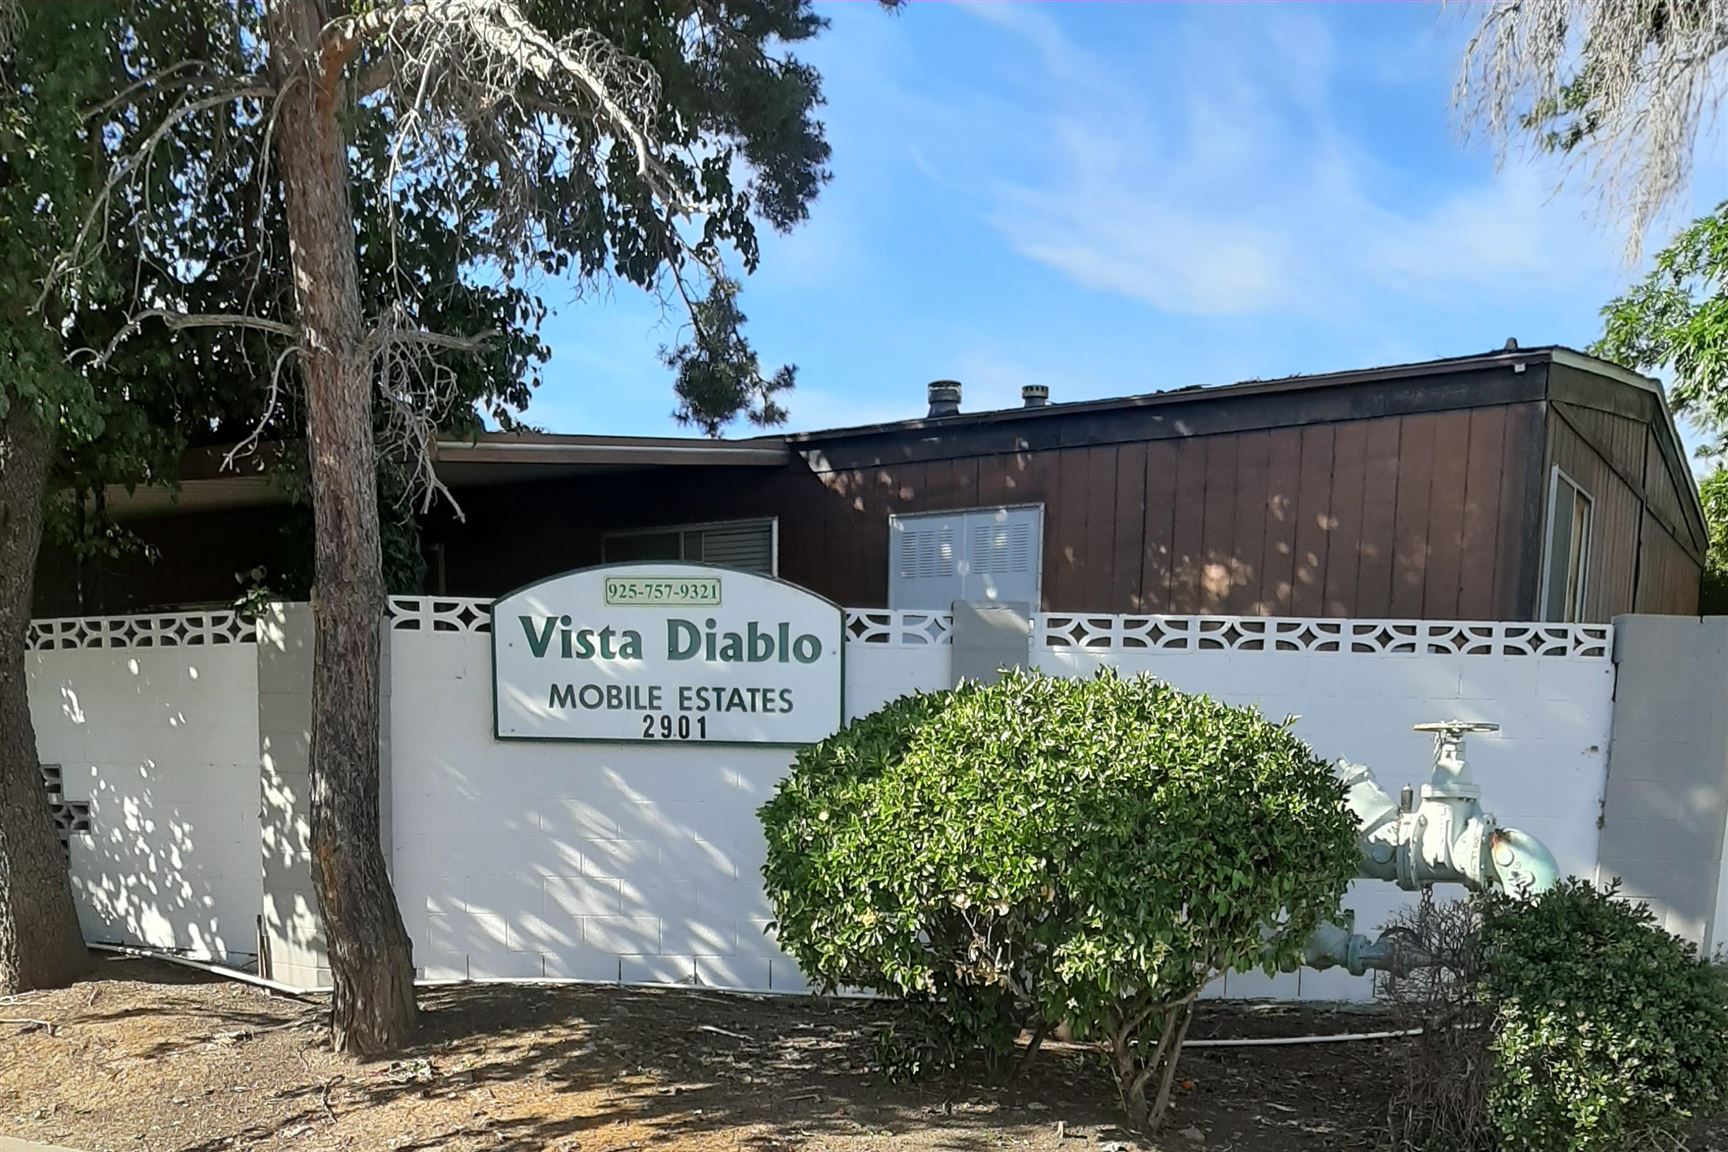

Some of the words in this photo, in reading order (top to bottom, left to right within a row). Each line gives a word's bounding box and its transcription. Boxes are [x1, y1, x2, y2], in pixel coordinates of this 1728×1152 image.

[608, 583, 717, 600] 925-757-9321
[519, 614, 644, 660] Vista
[666, 617, 823, 664] Diablo
[548, 683, 663, 711] MOBILE
[678, 685, 794, 714] ESTATES
[642, 714, 707, 739] 2901
